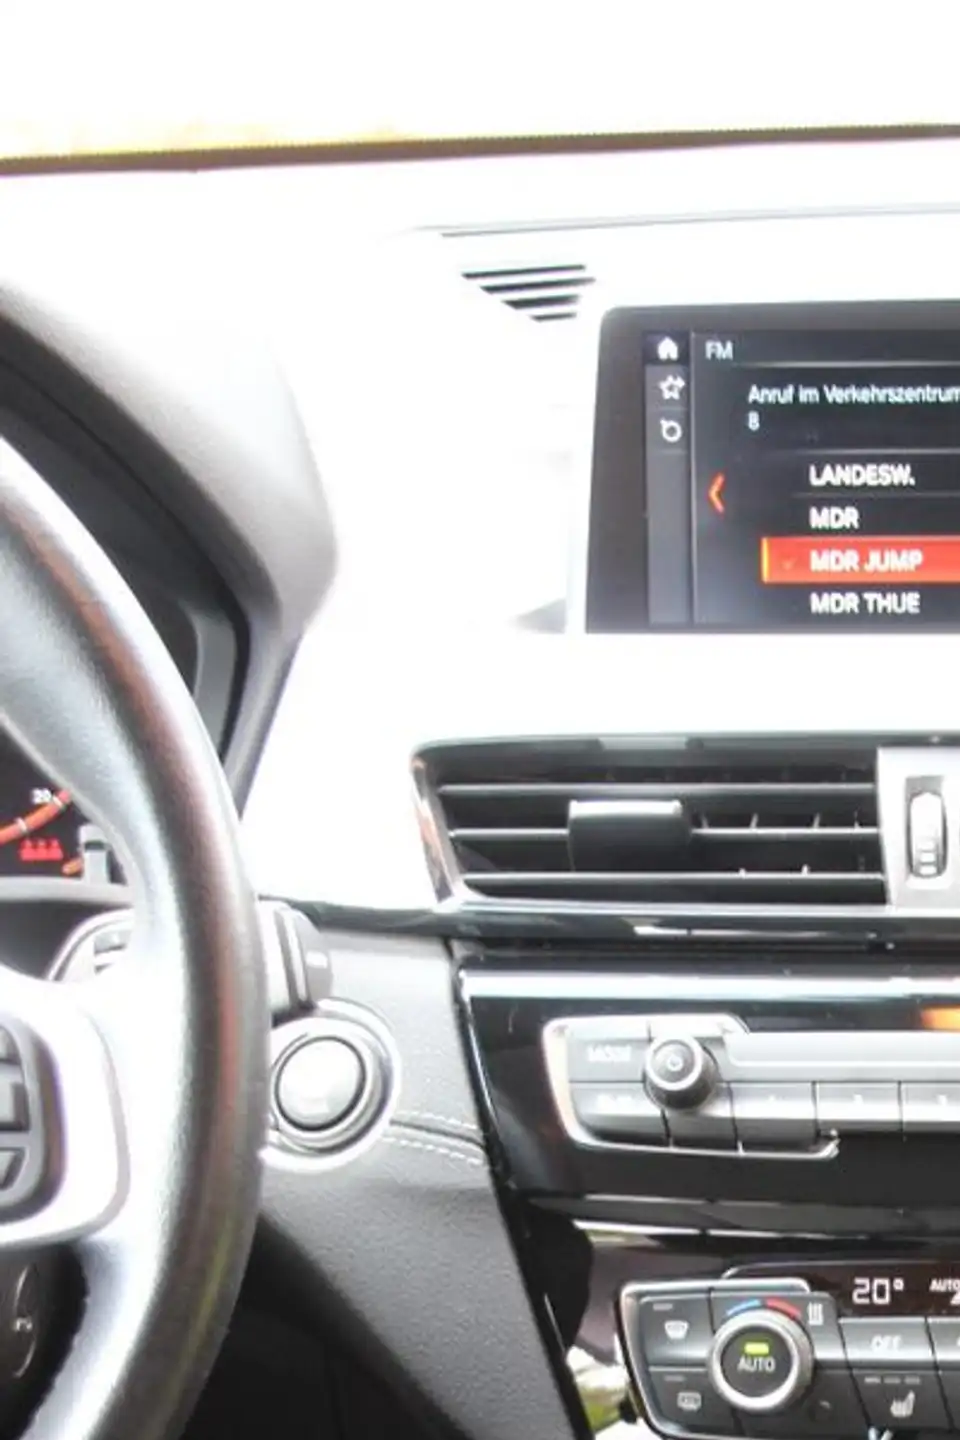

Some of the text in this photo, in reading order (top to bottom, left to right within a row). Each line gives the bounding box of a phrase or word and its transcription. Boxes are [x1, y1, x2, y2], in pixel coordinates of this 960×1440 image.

[704, 341, 733, 361] FM
[748, 383, 795, 404] Anruf
[799, 383, 819, 404] im
[809, 463, 915, 487] LANDESW.
[809, 506, 860, 530] MDR
[809, 548, 923, 573] MDR JUMP
[809, 591, 921, 615] MDR THUE
[737, 1356, 777, 1373] AUTO
